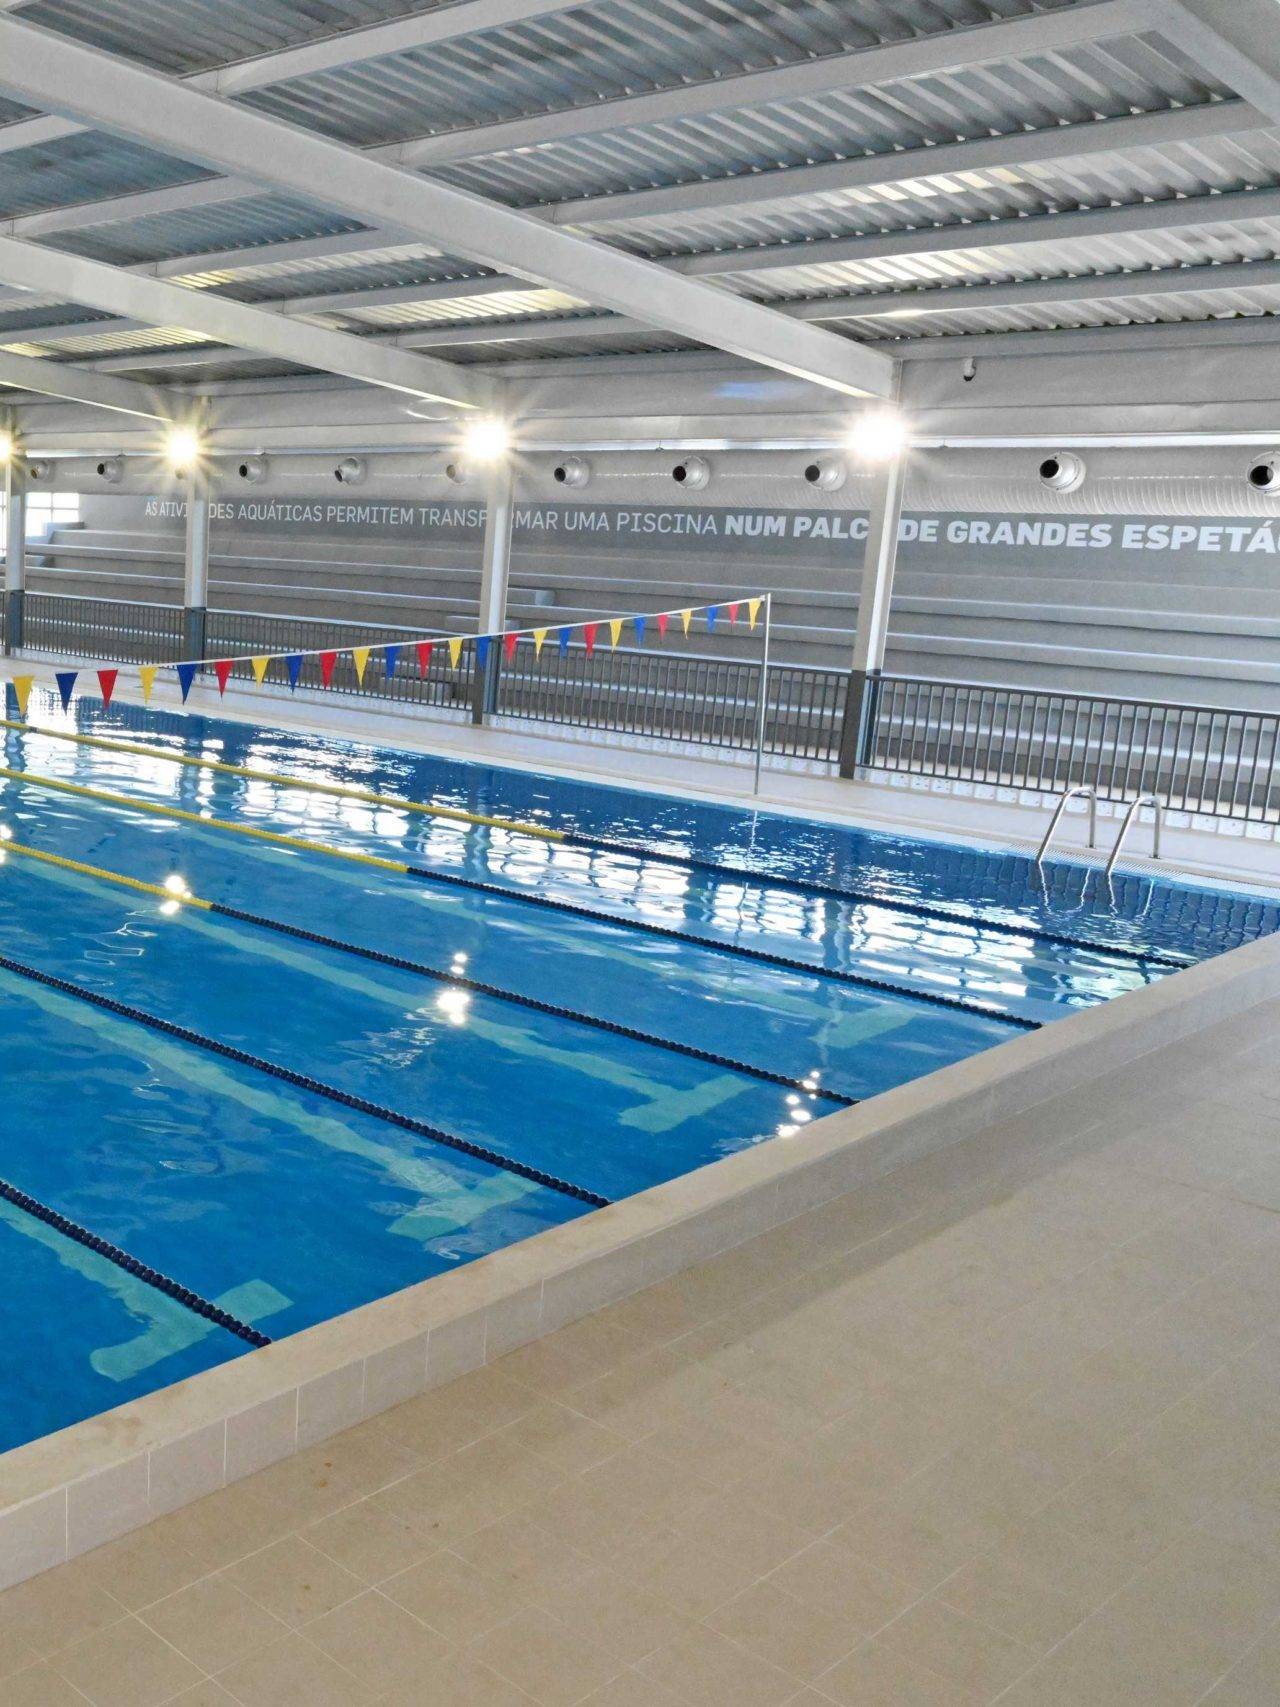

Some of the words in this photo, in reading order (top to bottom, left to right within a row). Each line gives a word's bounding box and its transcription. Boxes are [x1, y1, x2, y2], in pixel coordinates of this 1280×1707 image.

[145, 501, 158, 516] AS
[159, 502, 234, 519] ATIVIDES
[238, 500, 322, 522] AQUÁTICAS
[326, 506, 414, 525] PERMITEM
[418, 507, 558, 530] TRANSFMAR
[564, 511, 610, 531] UMA
[616, 512, 718, 535] PISCINA
[724, 515, 786, 537] NUM
[792, 516, 869, 539] PALC
[896, 519, 939, 542] DE
[946, 520, 1113, 548] GRANDES
[1121, 520, 1280, 554] ESPETÁ
